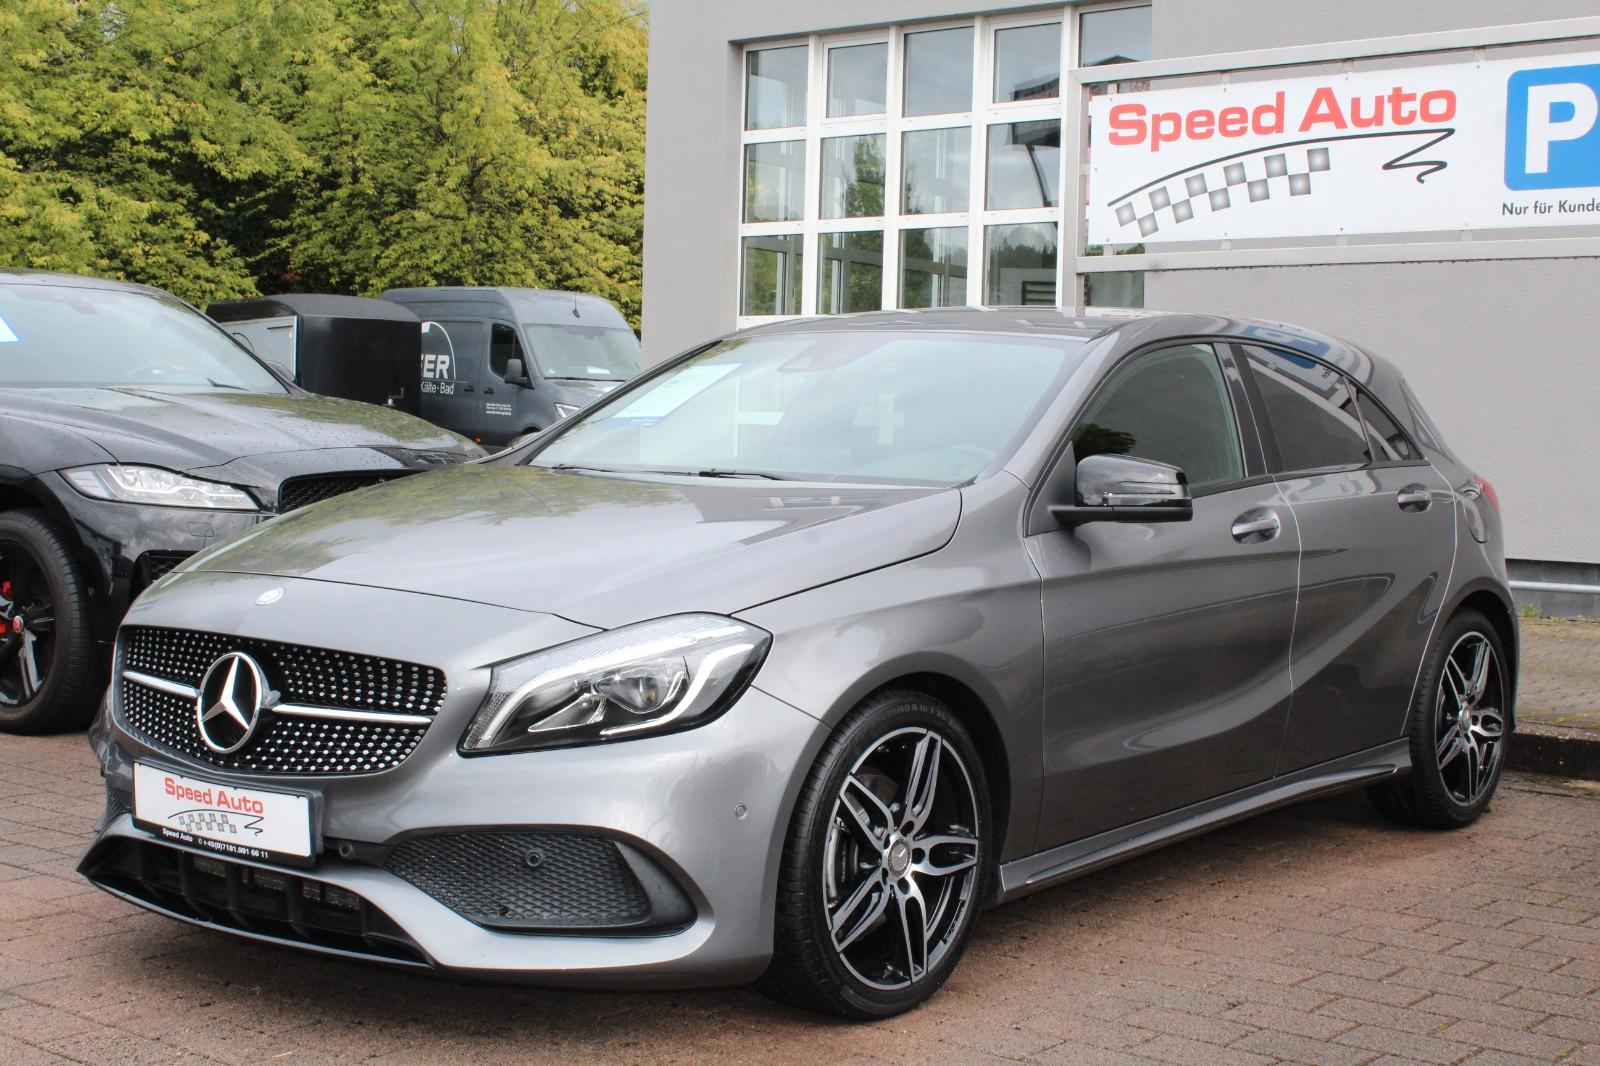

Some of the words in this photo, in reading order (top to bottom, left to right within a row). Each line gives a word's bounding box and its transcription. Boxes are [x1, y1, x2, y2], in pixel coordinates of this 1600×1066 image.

[1108, 91, 1285, 152] Speed
[1298, 86, 1457, 133] Auto
[1525, 83, 1598, 174] P
[1502, 202, 1528, 216] Nur
[1533, 200, 1553, 214] für
[421, 354, 449, 379] ER
[165, 777, 213, 805] Speed
[216, 790, 264, 814] Auto
[162, 828, 179, 838] Speed
[180, 832, 193, 841] Auto
